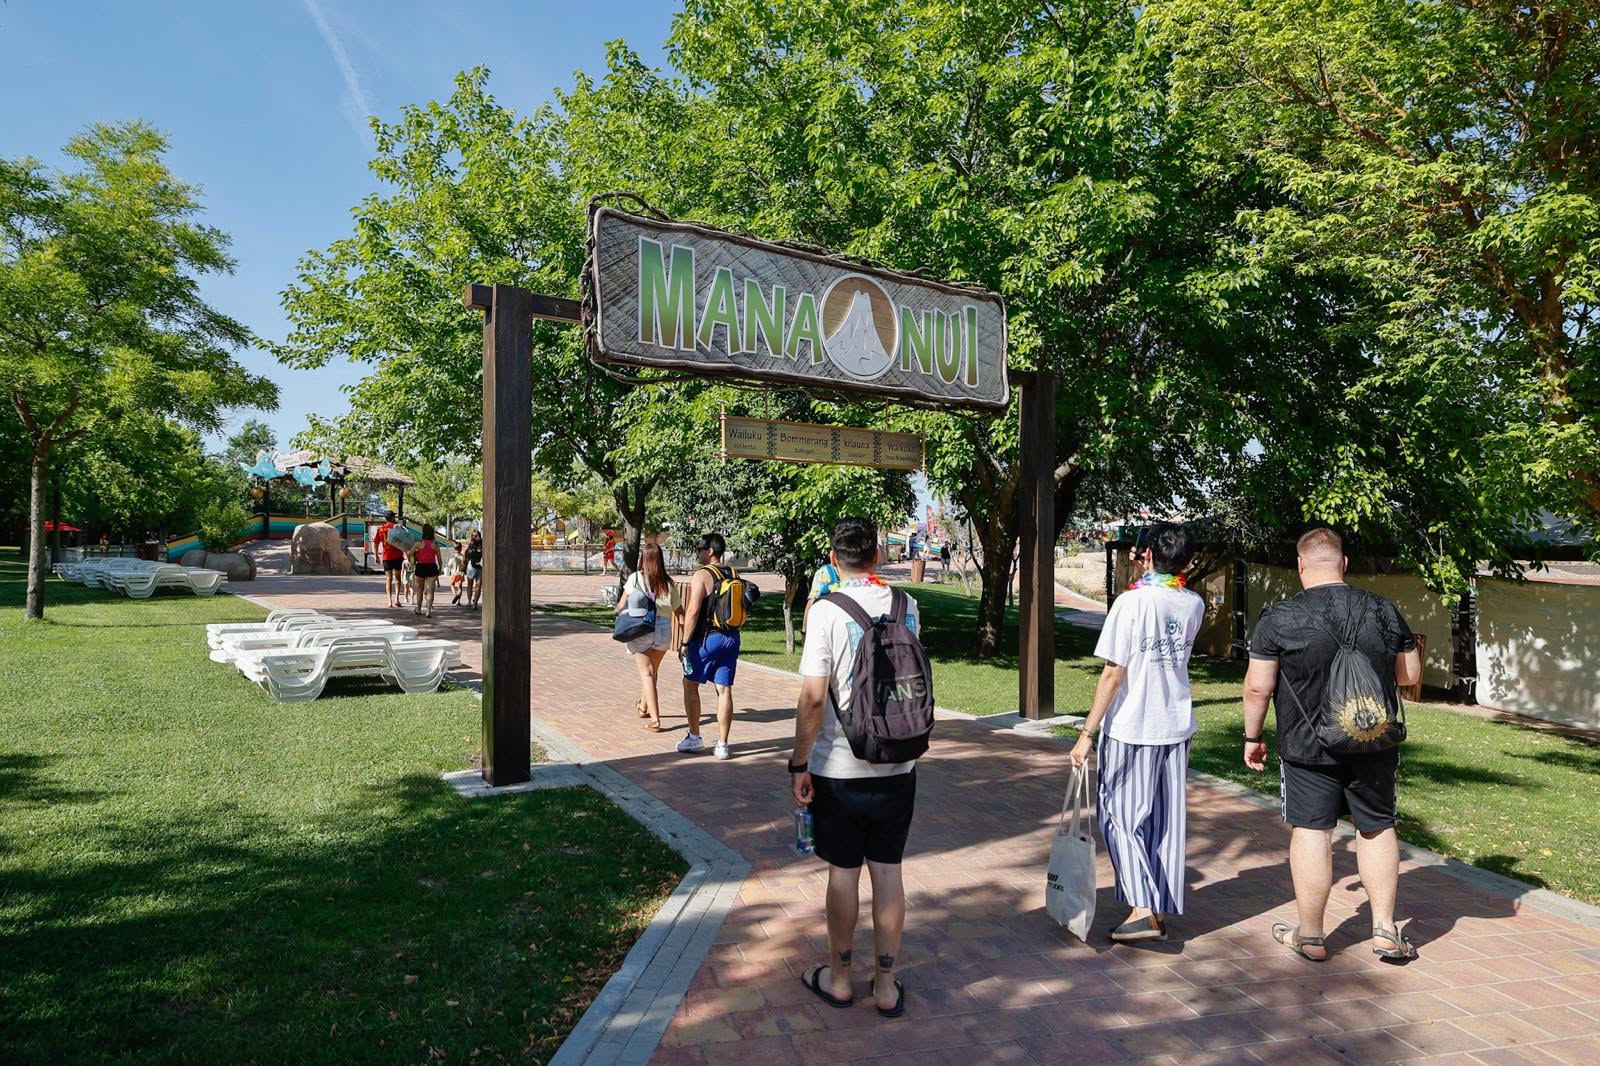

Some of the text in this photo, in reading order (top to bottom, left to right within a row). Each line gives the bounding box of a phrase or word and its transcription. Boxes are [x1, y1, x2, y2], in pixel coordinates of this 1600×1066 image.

[638, 235, 979, 388] MANA NUI
[729, 428, 762, 440] Wailuku
